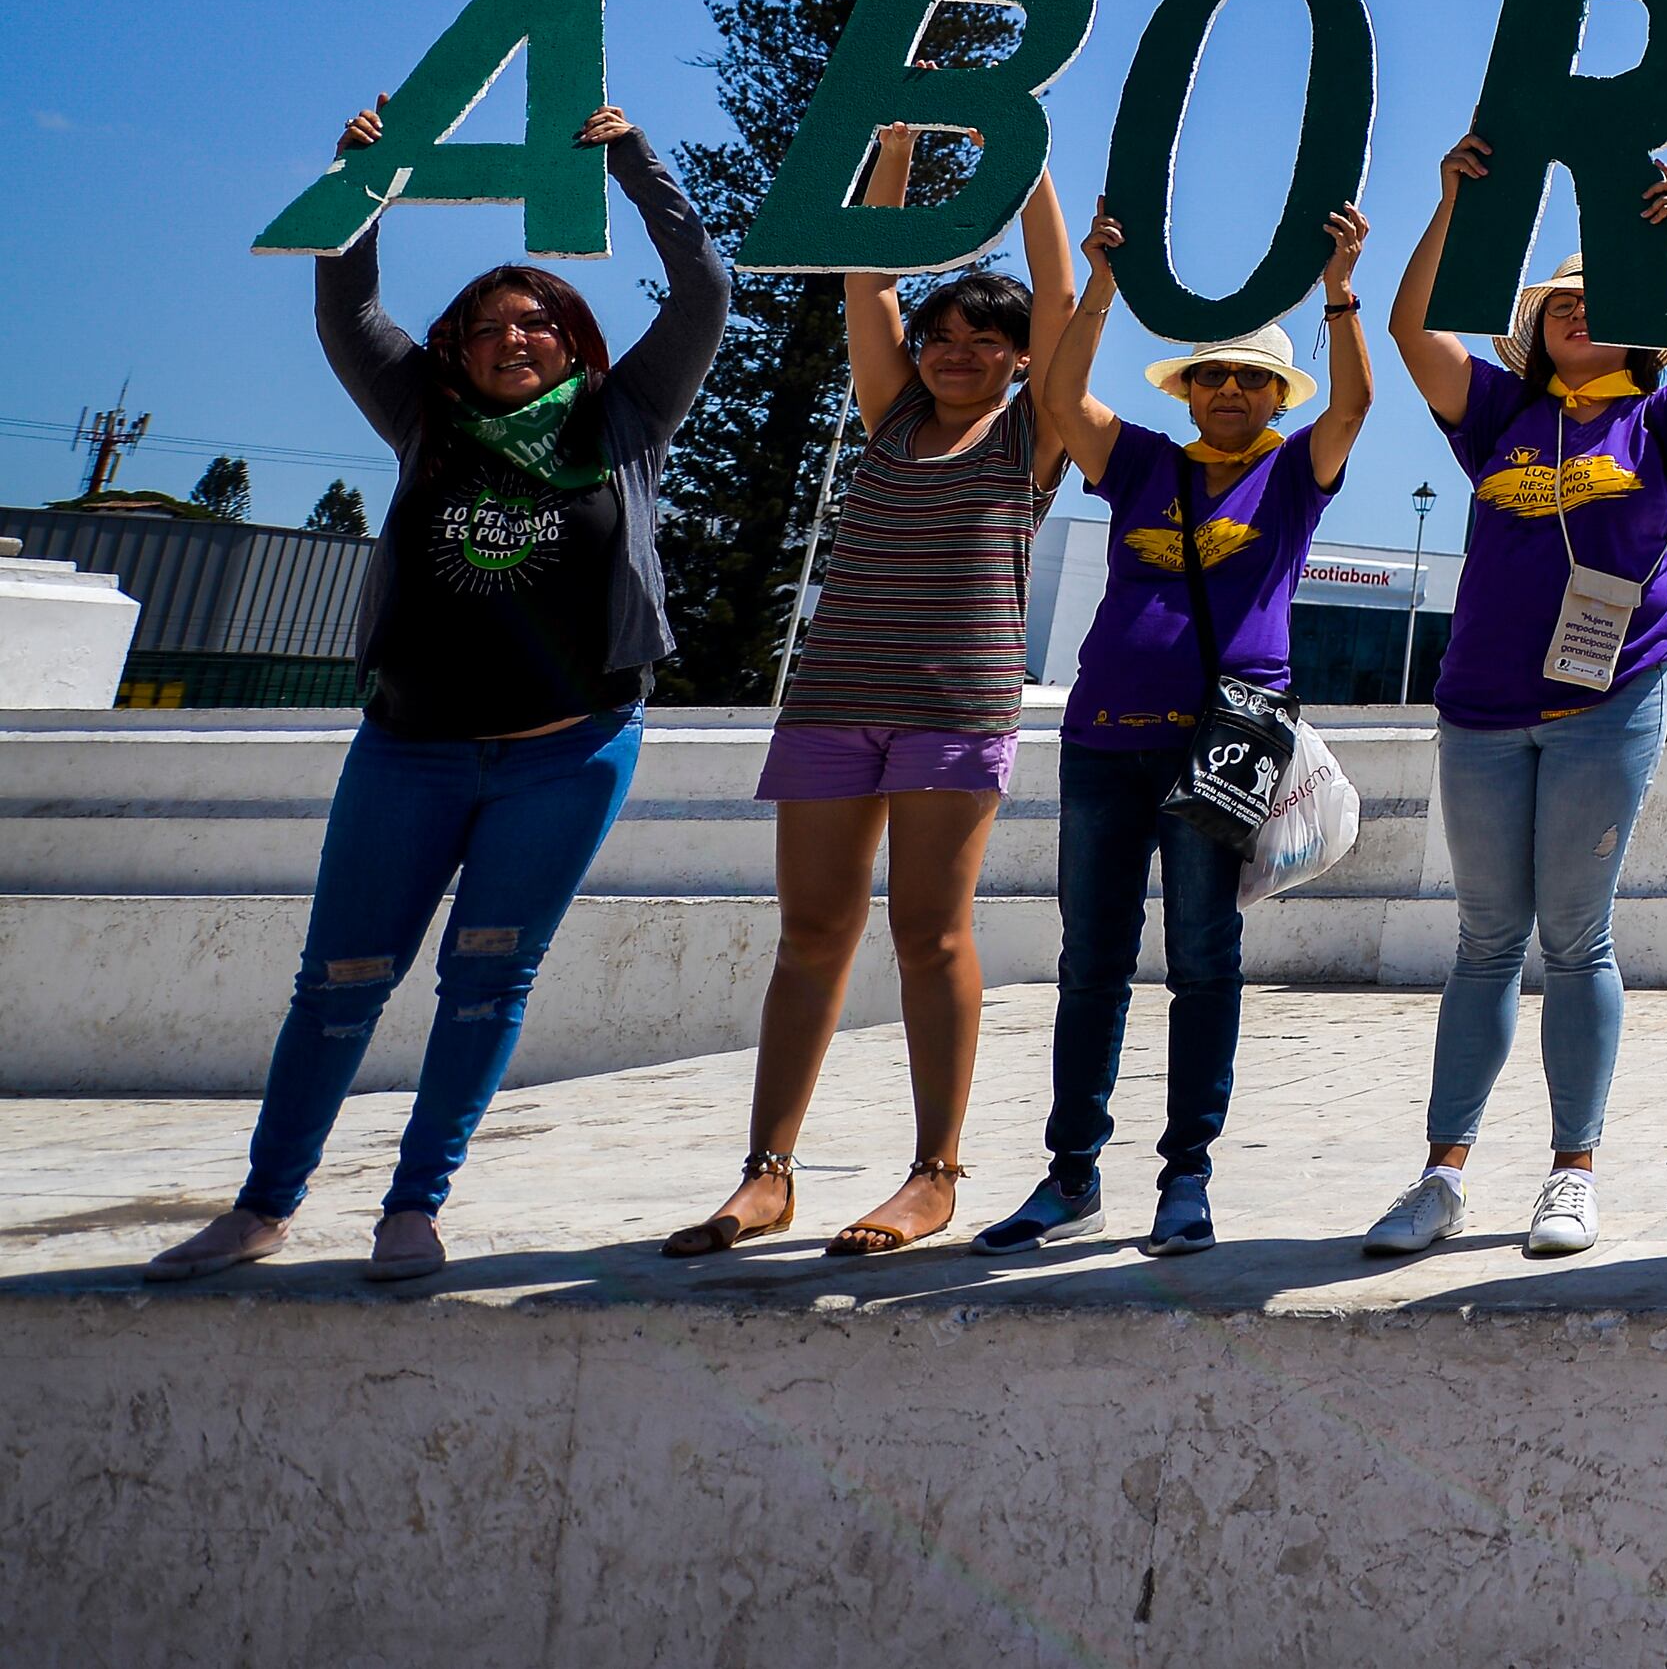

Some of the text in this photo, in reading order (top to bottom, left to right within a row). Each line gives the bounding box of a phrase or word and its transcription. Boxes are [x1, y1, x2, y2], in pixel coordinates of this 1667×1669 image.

[1519, 470, 1591, 491] RESISMOS
[443, 507, 467, 522] LO
[445, 525, 470, 540] ES
[1302, 564, 1389, 586] Scotiabank
[1564, 634, 1616, 652] participación
